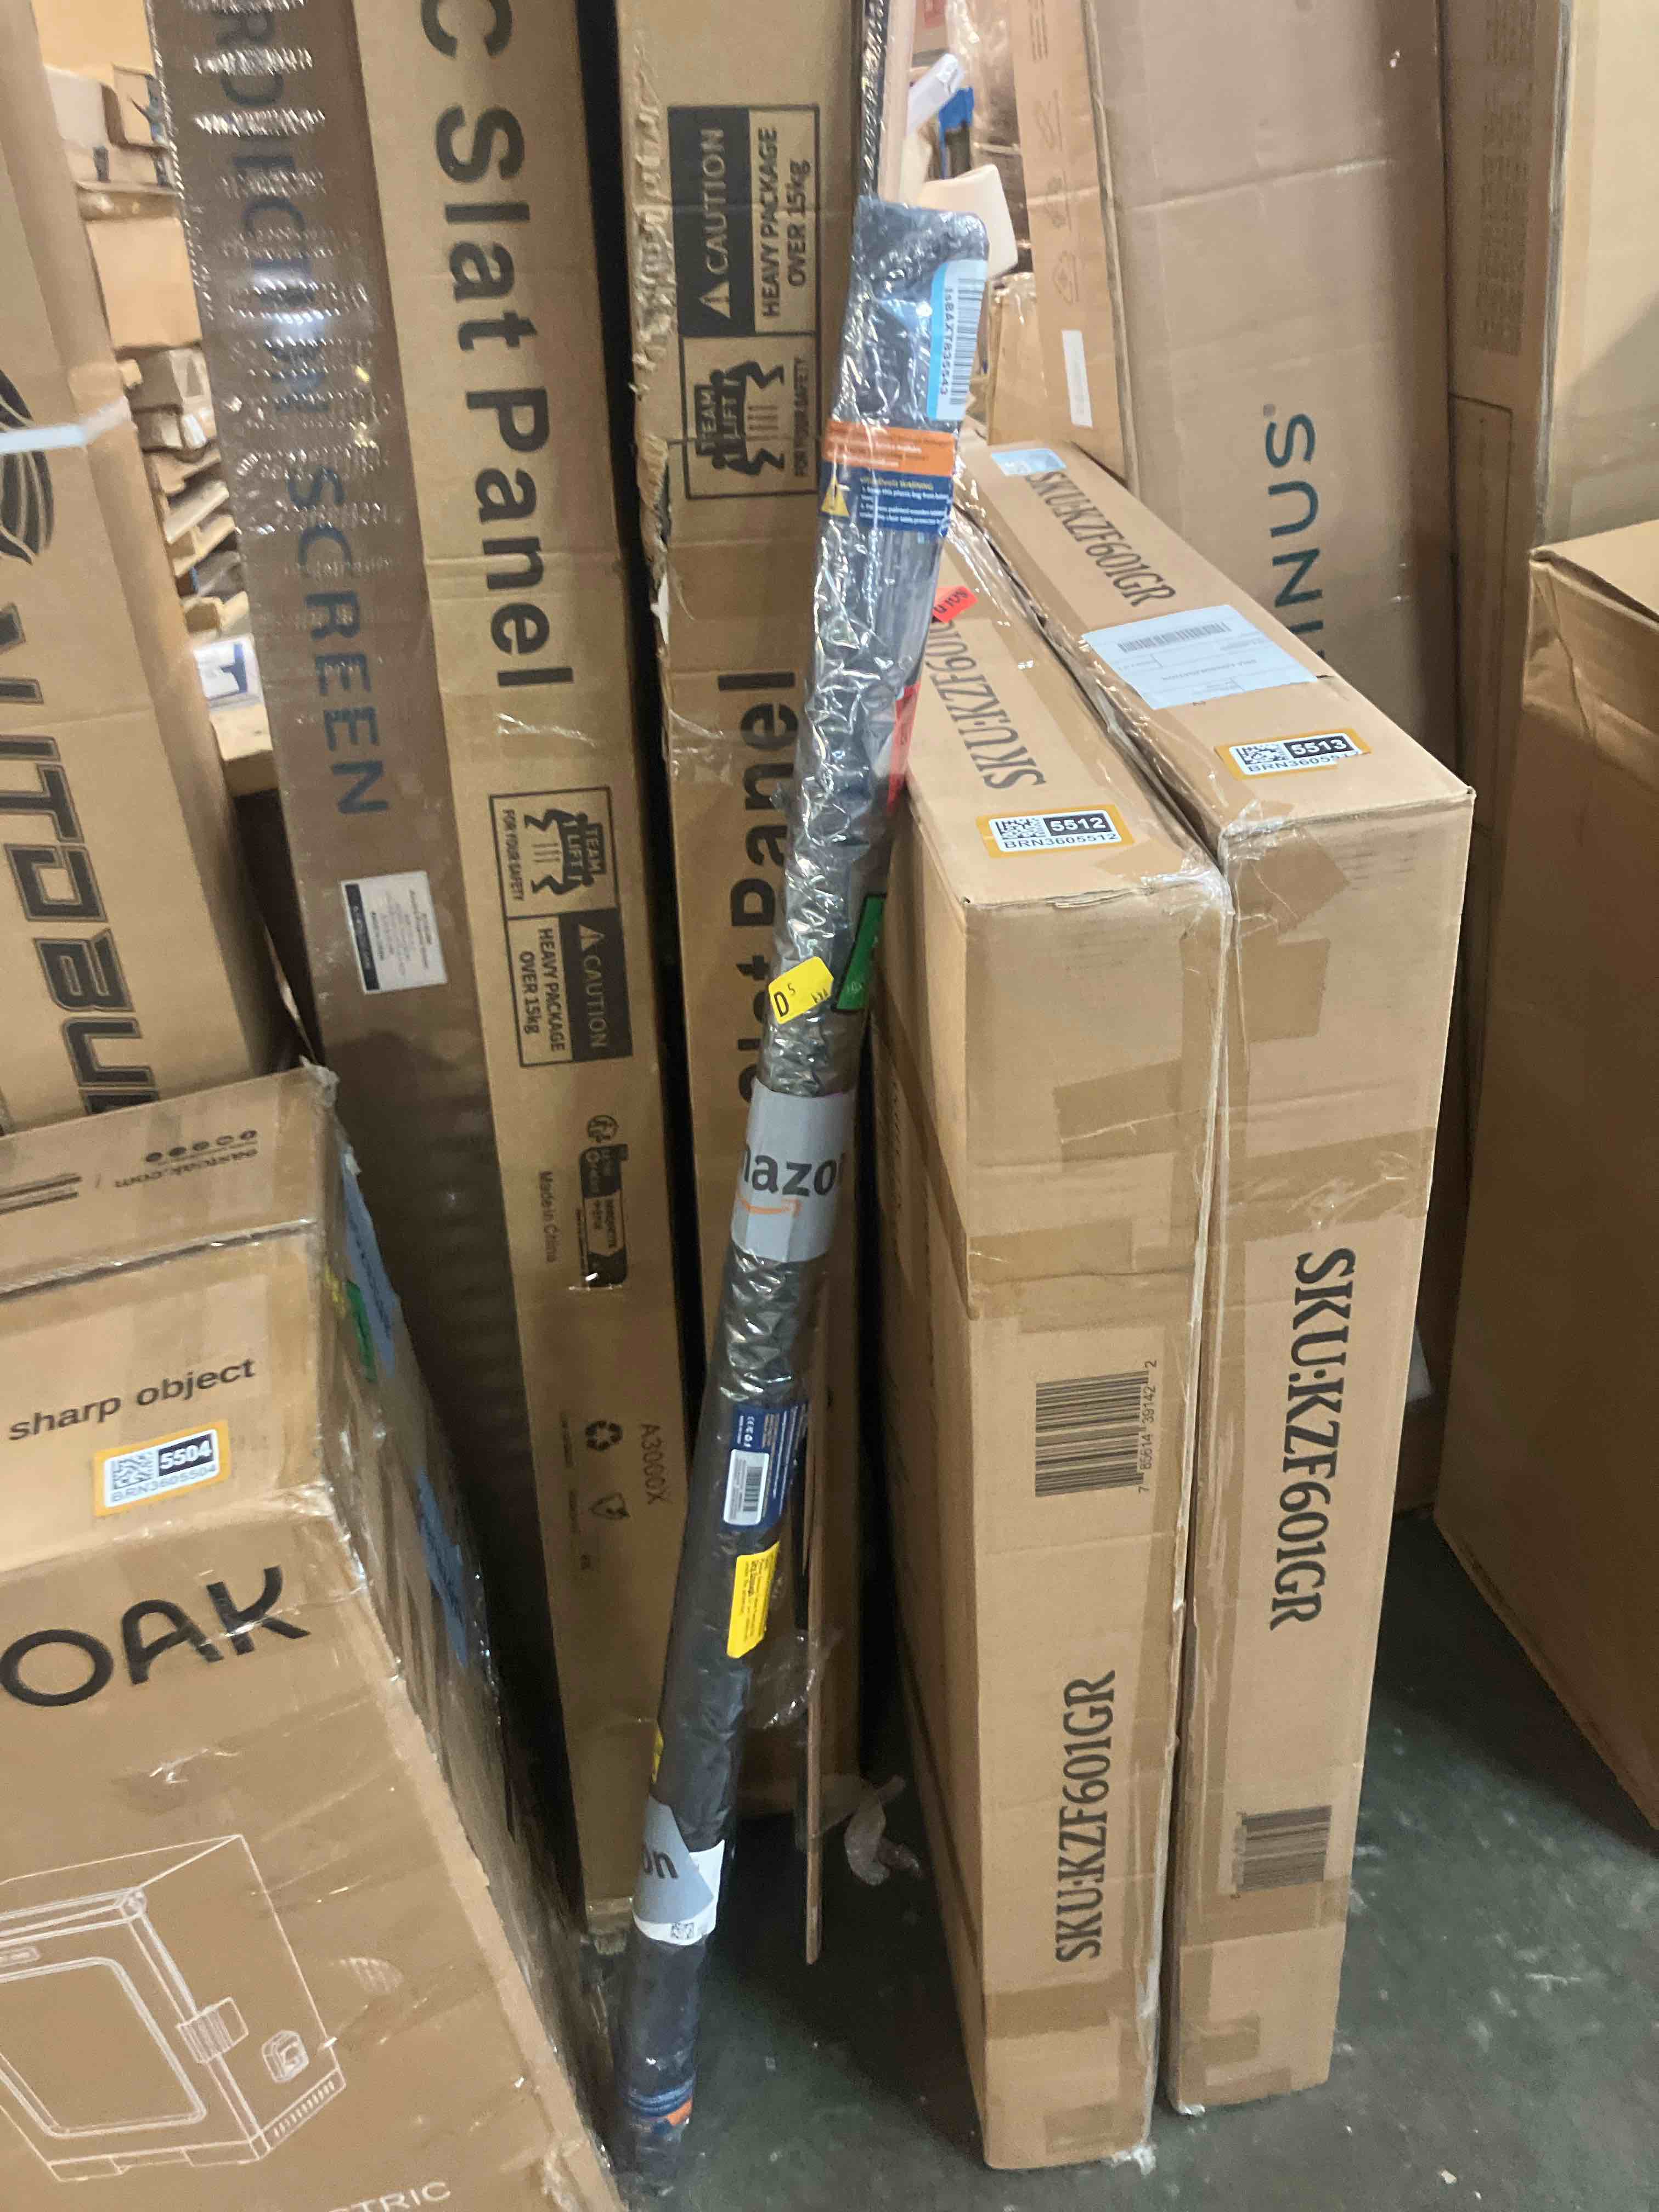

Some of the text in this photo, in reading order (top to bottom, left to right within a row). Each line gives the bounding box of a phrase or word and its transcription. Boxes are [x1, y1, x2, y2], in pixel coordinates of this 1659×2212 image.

[435, 105, 537, 352] Slat
[700, 127, 730, 274] CAUTION
[757, 127, 781, 318] HEAVY PACKAGE
[785, 159, 810, 287] OVER 15kg
[699, 387, 715, 452] TEAM
[720, 394, 738, 436] LIFT
[465, 386, 575, 689] Panel
[1265, 413, 1325, 658] INUS
[287, 466, 387, 814] SCREEN
[1290, 738, 1348, 756] 5513
[503, 809, 524, 901] FOR YOUR SAFETY
[567, 833, 583, 870] LIFT
[584, 828, 602, 874] TEAM
[1004, 831, 1118, 849] BRN3605512
[1051, 816, 1107, 833] 5512
[519, 951, 541, 1035] OVER 15kg
[538, 928, 566, 1052] HEAVY PACKAGE
[582, 955, 608, 1048] CAUTION
[543, 1223, 560, 1262] China
[8, 1357, 256, 1442] sharp object
[1141, 1386, 1156, 1424] 39142
[1144, 1360, 1157, 1368] 2
[159, 1438, 213, 1470] 5504
[1268, 1246, 1357, 1632] SKU:KZF601GR
[0, 1565, 312, 1707] OAK
[1054, 1669, 1116, 1964] SKU:KZF601GR
[328, 2181, 452, 2212] TRIC
